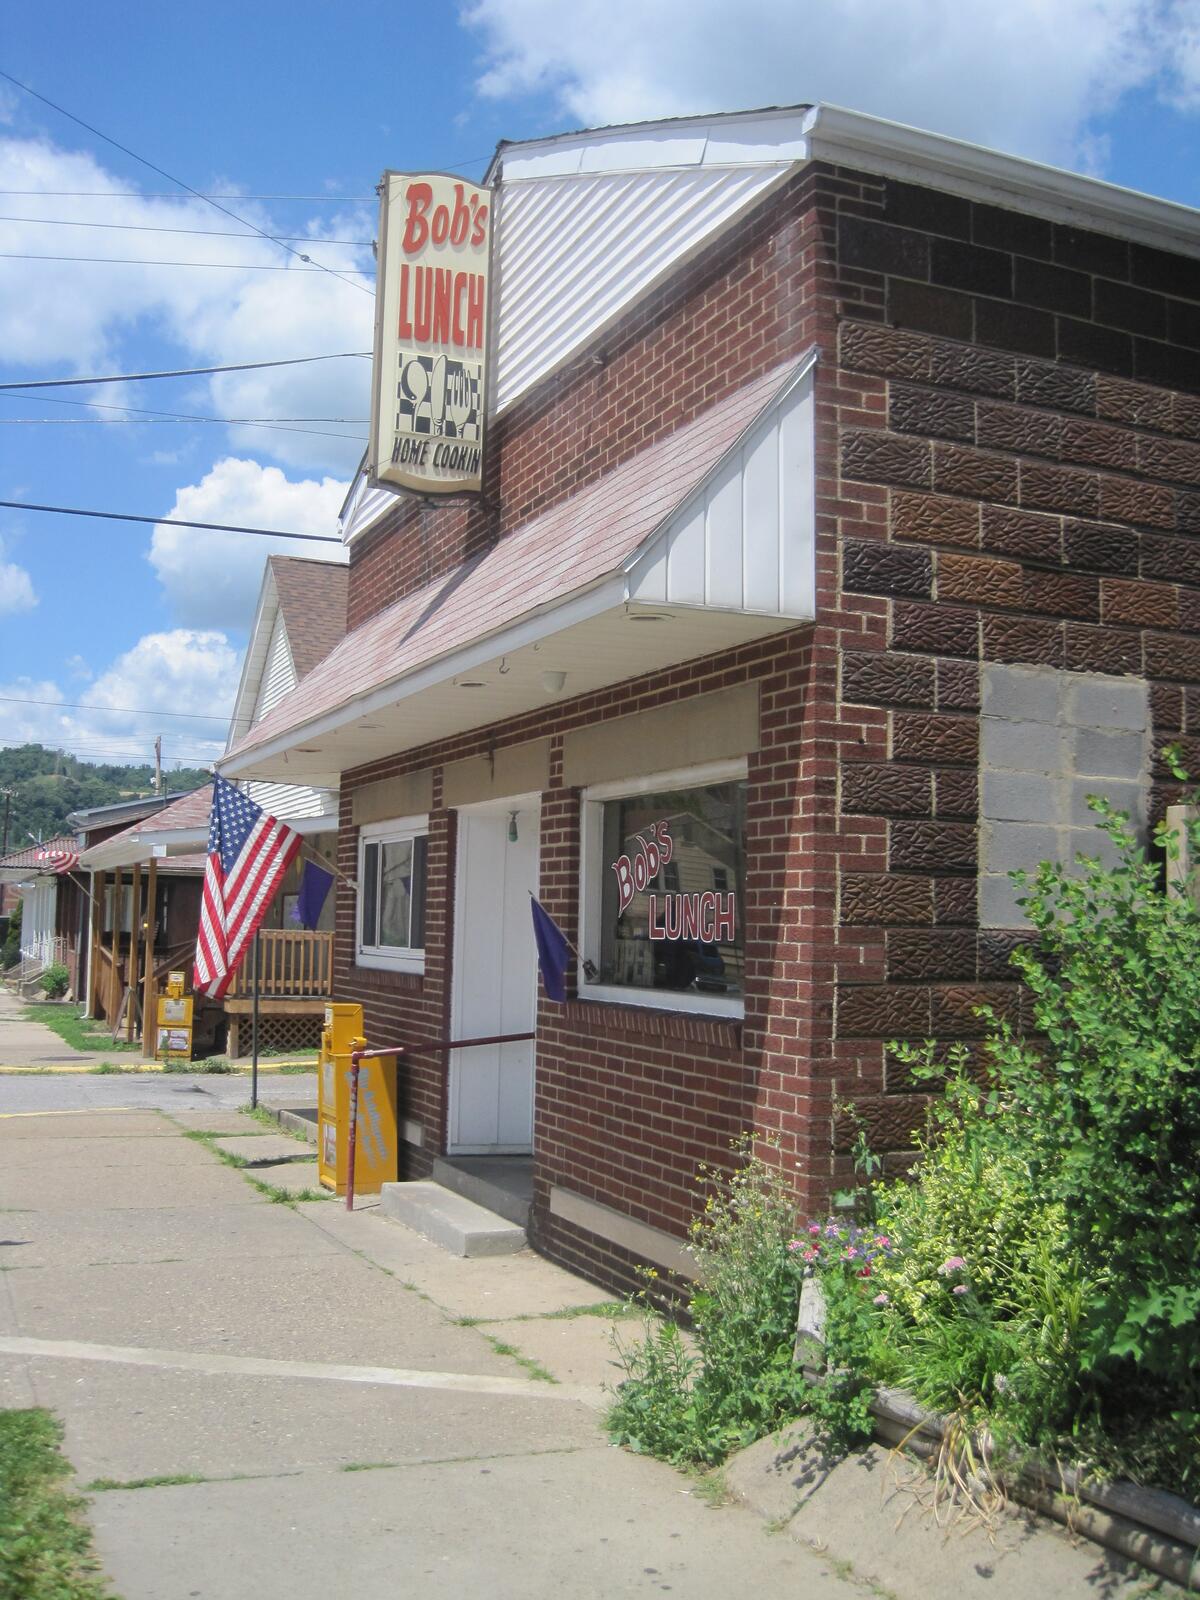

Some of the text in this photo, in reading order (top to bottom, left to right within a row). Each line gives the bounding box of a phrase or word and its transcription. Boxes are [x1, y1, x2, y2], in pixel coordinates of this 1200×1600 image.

[402, 183, 488, 254] Bob's
[398, 264, 485, 349] LUNCH
[391, 437, 430, 466] HOME
[611, 820, 673, 918] Bob's
[649, 891, 735, 943] LUNCH
